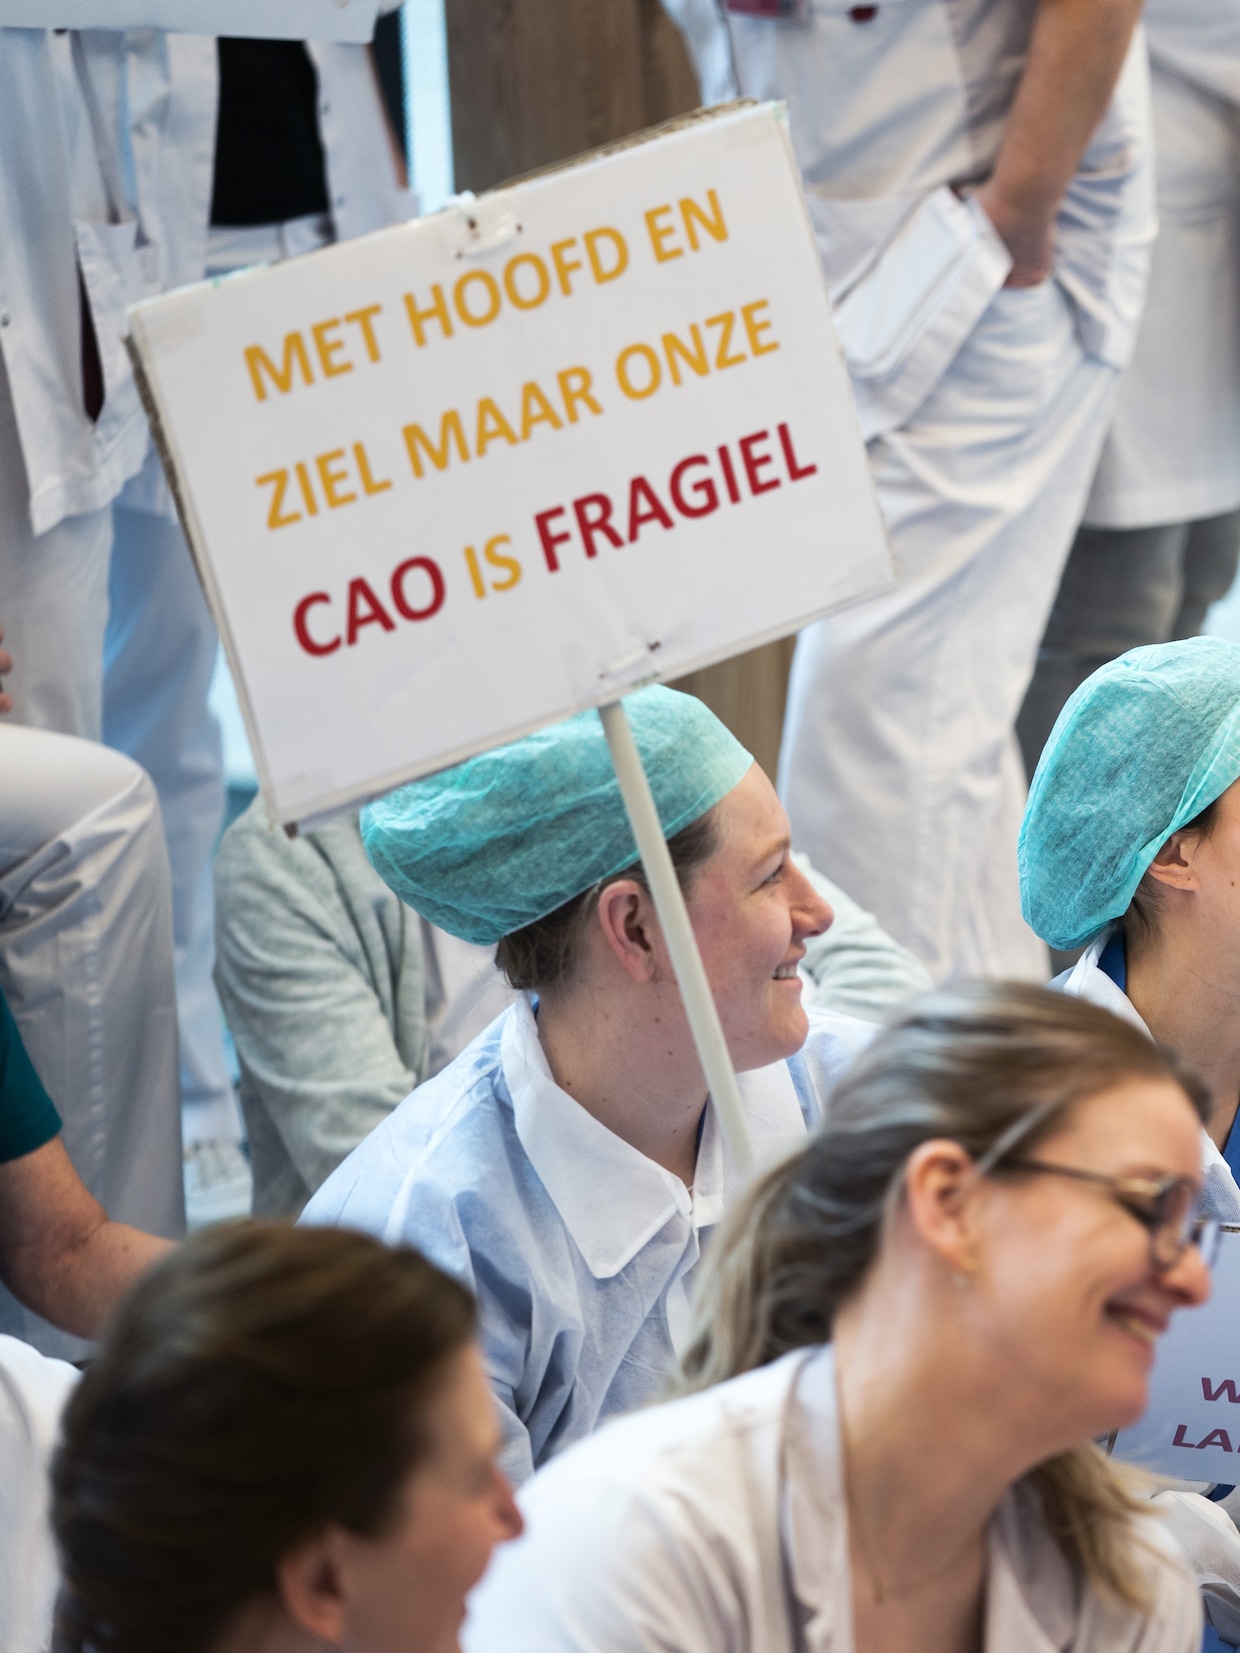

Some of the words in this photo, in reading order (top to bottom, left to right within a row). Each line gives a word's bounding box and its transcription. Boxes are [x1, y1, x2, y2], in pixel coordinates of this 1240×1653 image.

[243, 303, 383, 402] MET
[403, 226, 631, 348] HOOFD
[643, 188, 730, 265] EN
[255, 441, 393, 531] ZIEL
[401, 365, 603, 479] MAAR
[614, 298, 780, 402] ONZE
[293, 556, 446, 658] CAO
[463, 533, 523, 600] IS
[534, 422, 818, 573] FRAGIEL
